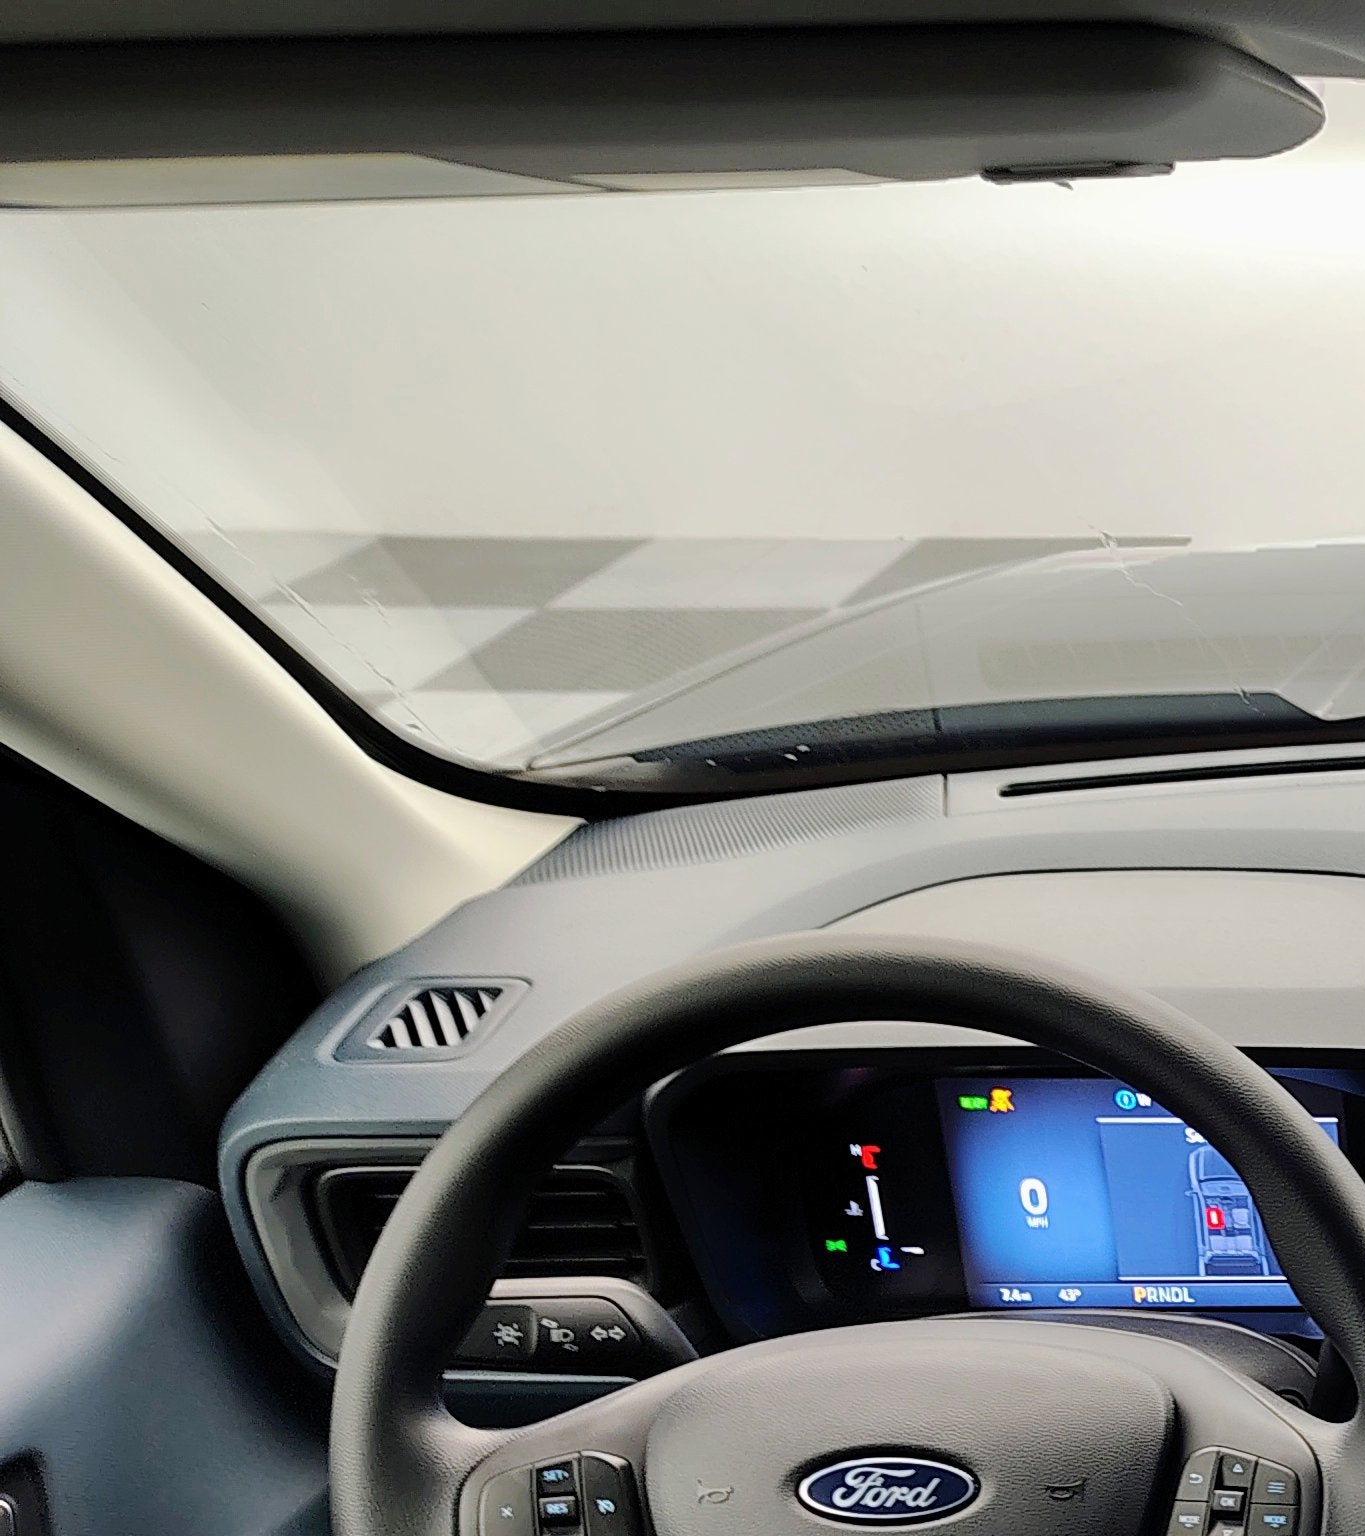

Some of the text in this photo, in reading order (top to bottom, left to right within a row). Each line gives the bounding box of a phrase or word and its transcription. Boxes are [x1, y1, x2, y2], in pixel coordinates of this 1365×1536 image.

[1020, 1177, 1048, 1216] 0
[1025, 1215, 1049, 1229] MPH
[832, 1466, 942, 1508] Ford
[545, 1503, 569, 1515] RES
